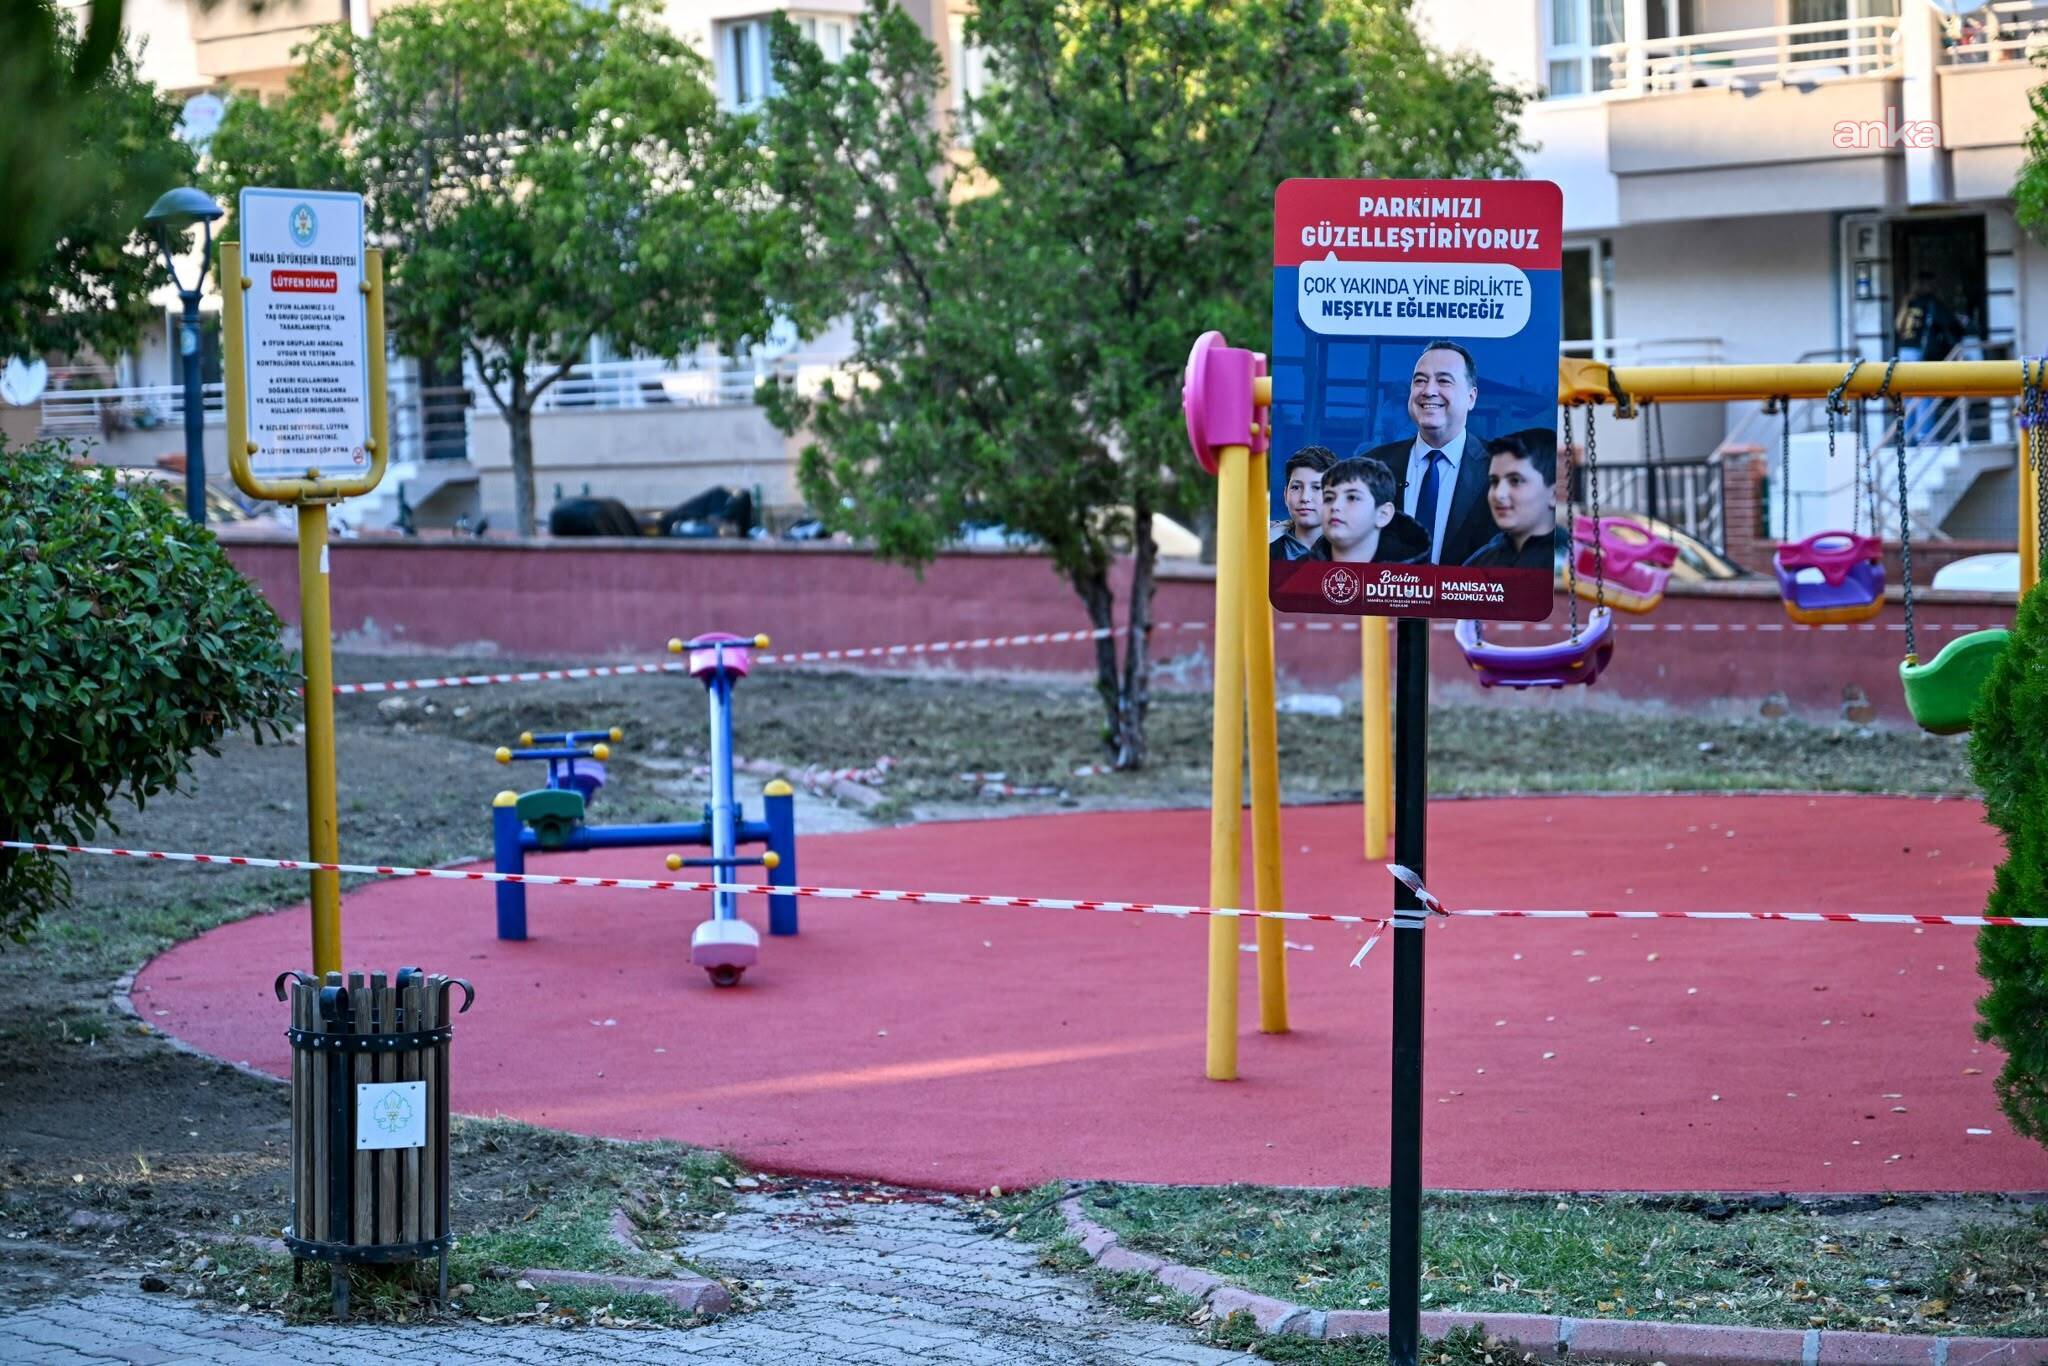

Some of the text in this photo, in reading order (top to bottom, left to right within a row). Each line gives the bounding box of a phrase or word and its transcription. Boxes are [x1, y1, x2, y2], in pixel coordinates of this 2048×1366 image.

[1359, 196, 1482, 218] PARKIMIZI
[1301, 220, 1540, 252] GÜZELLEŞTİRİYORUZ
[249, 252, 357, 267] MANİSA BÜYÜKŞEHİR BELEDİYESİ
[272, 275, 335, 288] LÜTFEN DİKKAT
[1304, 275, 1524, 297] ÇOK YAKINDA YİNE BİRLİKTE
[1322, 297, 1505, 321] NEŞEYLE EĞLENECEĞİZ
[1380, 569, 1421, 584] Besim
[1366, 583, 1434, 598] DUTLULU
[1441, 581, 1505, 592] MANİSA'YA
[1485, 594, 1505, 602] VAR
